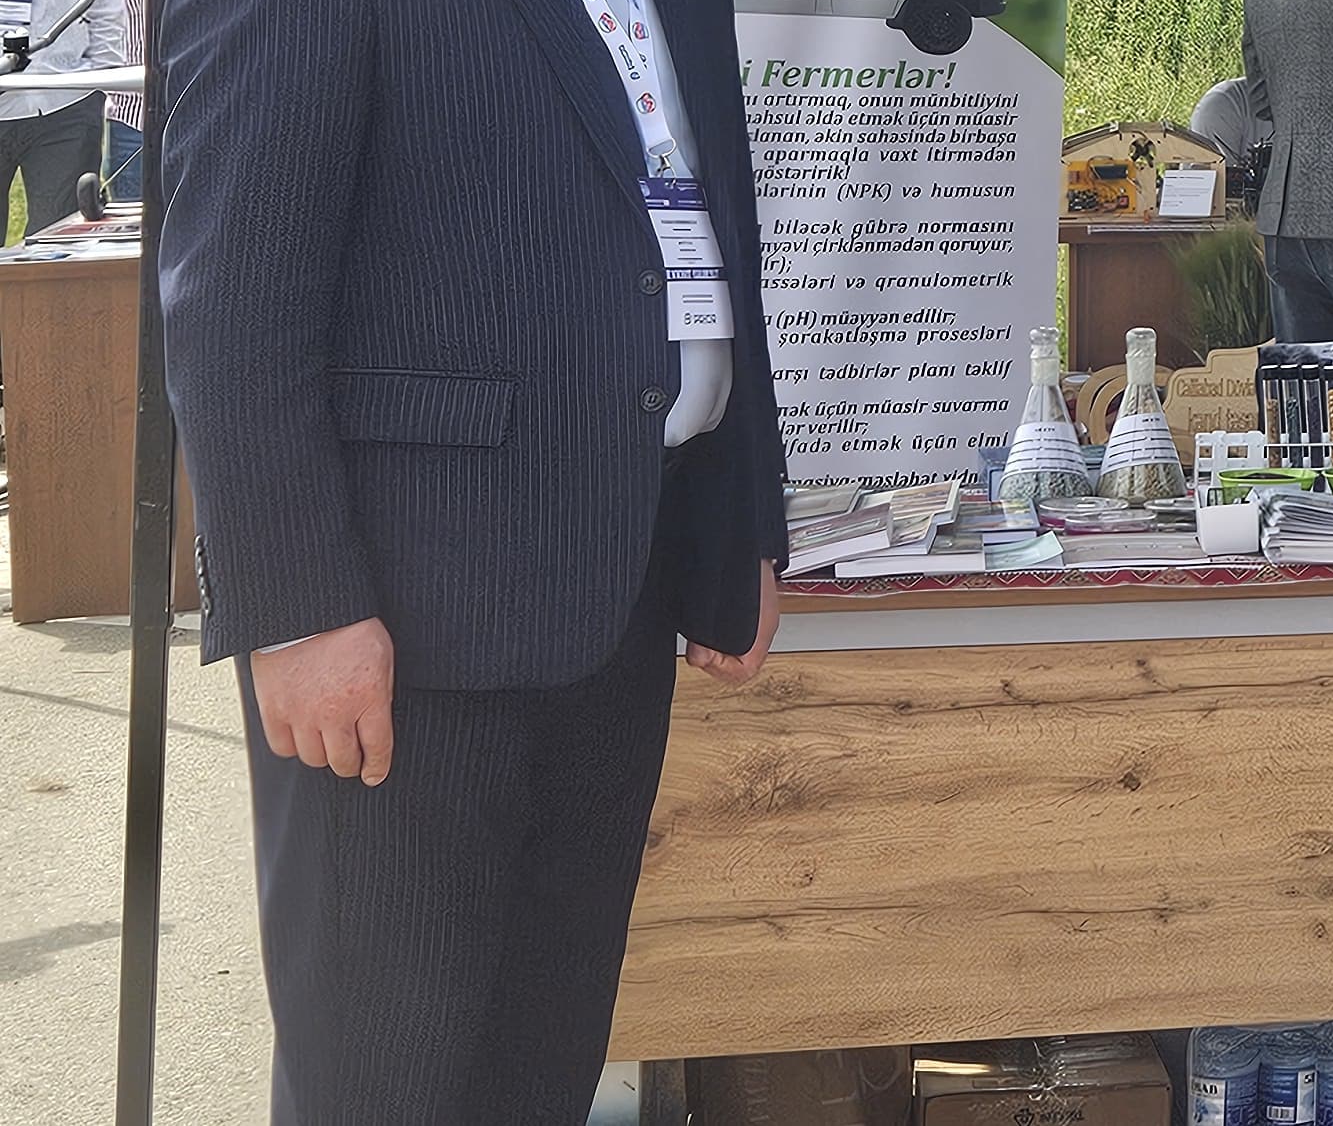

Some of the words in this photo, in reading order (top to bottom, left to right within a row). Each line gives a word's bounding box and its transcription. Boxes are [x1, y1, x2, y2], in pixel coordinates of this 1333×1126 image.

[761, 59, 956, 89] Fermerlər!
[858, 95, 903, 107] onun
[805, 110, 843, 125] əldə
[848, 110, 904, 126] etmək
[907, 112, 951, 130] üçün
[955, 111, 1019, 126] müasir
[748, 128, 811, 145] lanan,
[813, 128, 853, 144] əkin
[856, 128, 946, 144] sahəsində
[950, 127, 1017, 148] birbaşa
[763, 146, 869, 165] aparmaqla
[880, 148, 918, 162] vaxt
[837, 183, 892, 203] (NPK)
[902, 185, 922, 199] və
[931, 183, 1016, 199] humusun
[773, 219, 843, 235] biləcək
[851, 220, 908, 241] gübrə
[938, 237, 1014, 256] qoruyur,
[846, 275, 866, 289] və
[875, 271, 1014, 294] qranulometrik
[776, 309, 817, 330] (pH)
[821, 311, 899, 333] müəyyən
[917, 325, 1011, 346] prosesləri
[819, 363, 901, 381] tədbirlər
[907, 361, 956, 381] planı
[965, 360, 1014, 381] təklif
[815, 401, 857, 420] üçün
[863, 399, 928, 415] müasir
[931, 399, 1009, 414] suvarma
[841, 434, 901, 452] etmək
[912, 434, 957, 454] üçün
[968, 431, 1008, 448] elmi
